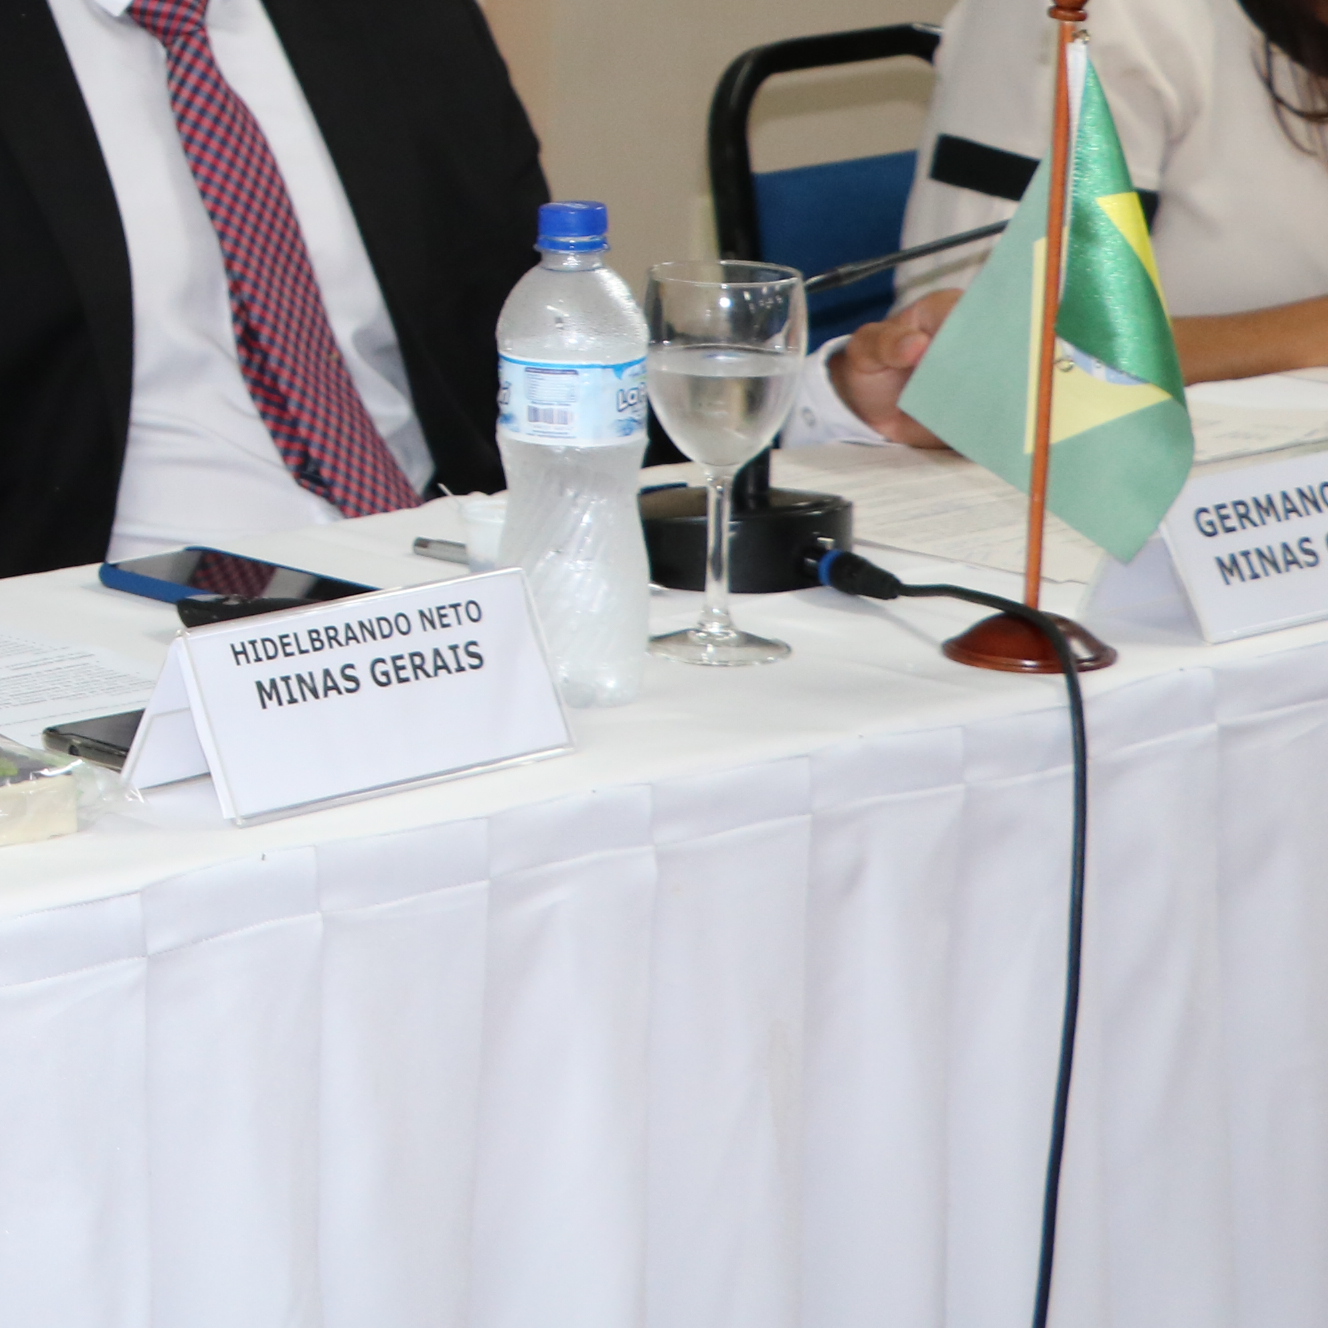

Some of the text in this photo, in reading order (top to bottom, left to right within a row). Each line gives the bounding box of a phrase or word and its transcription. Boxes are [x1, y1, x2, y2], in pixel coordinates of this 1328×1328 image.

[1214, 535, 1320, 586] MINAS
[230, 599, 483, 666] HIDELBRANDO NETO
[255, 640, 485, 710] MINAS GERAIS
